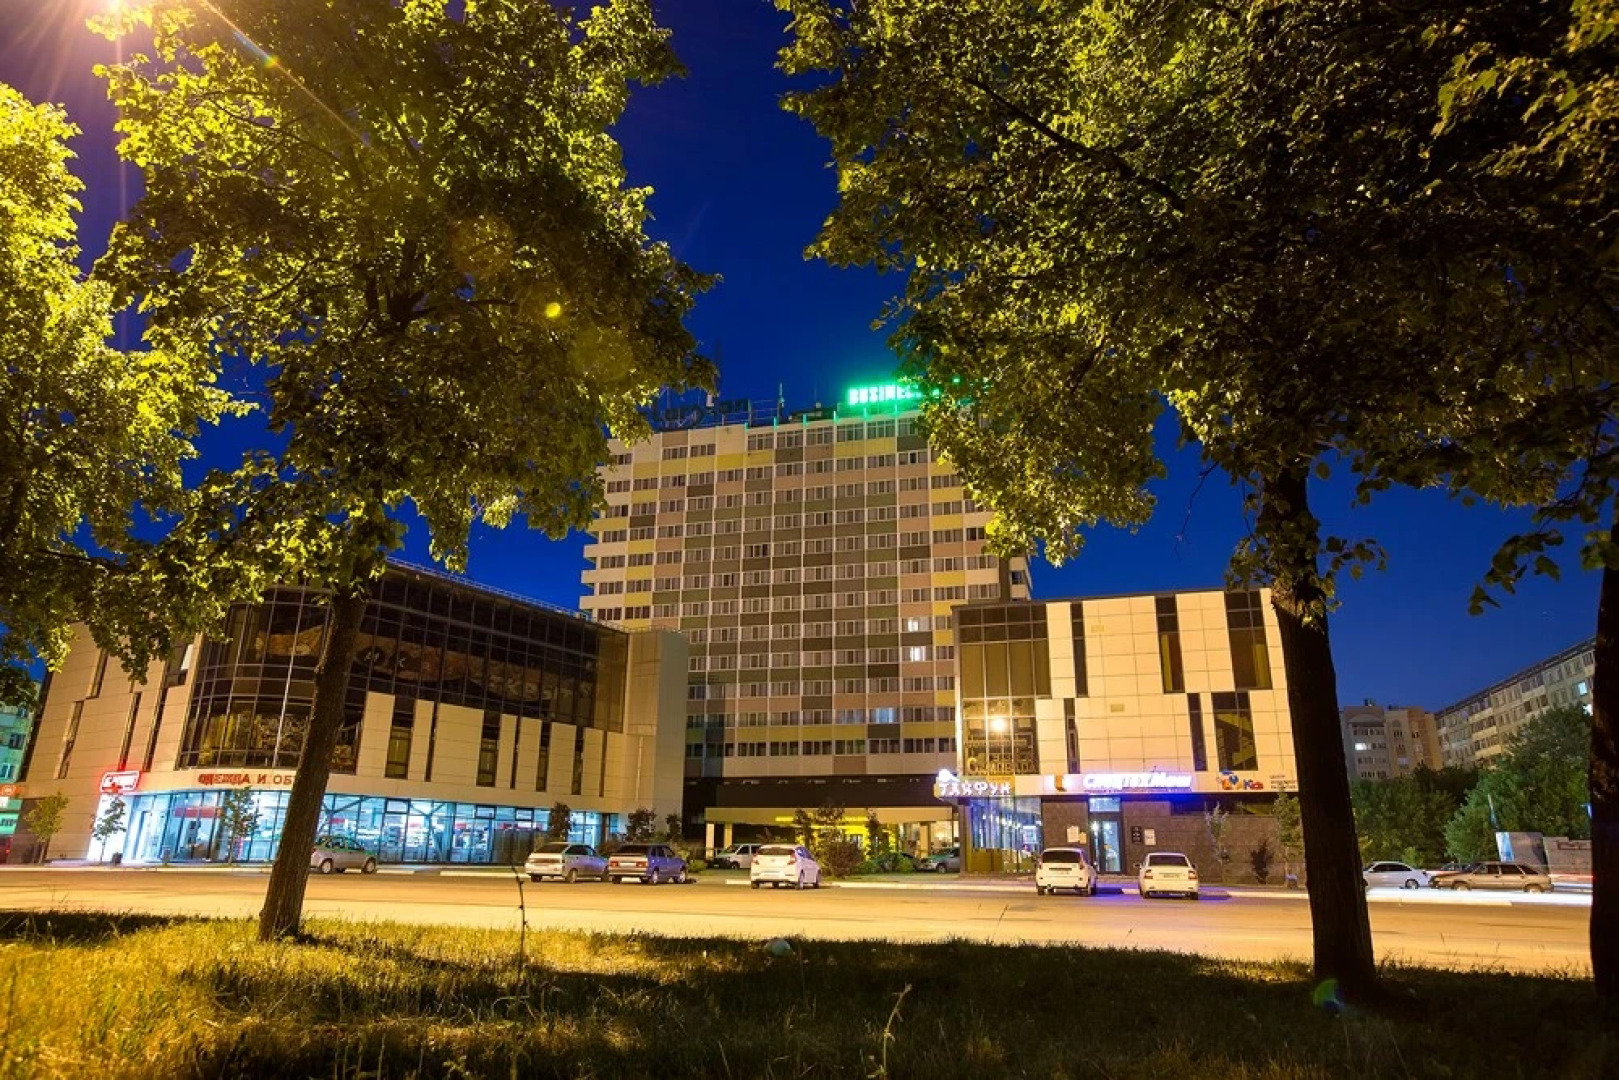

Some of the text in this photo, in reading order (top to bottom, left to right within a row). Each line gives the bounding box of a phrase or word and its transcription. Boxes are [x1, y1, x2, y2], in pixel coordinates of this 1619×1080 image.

[198, 774, 294, 785] ОДЕЖДА И ОБ
